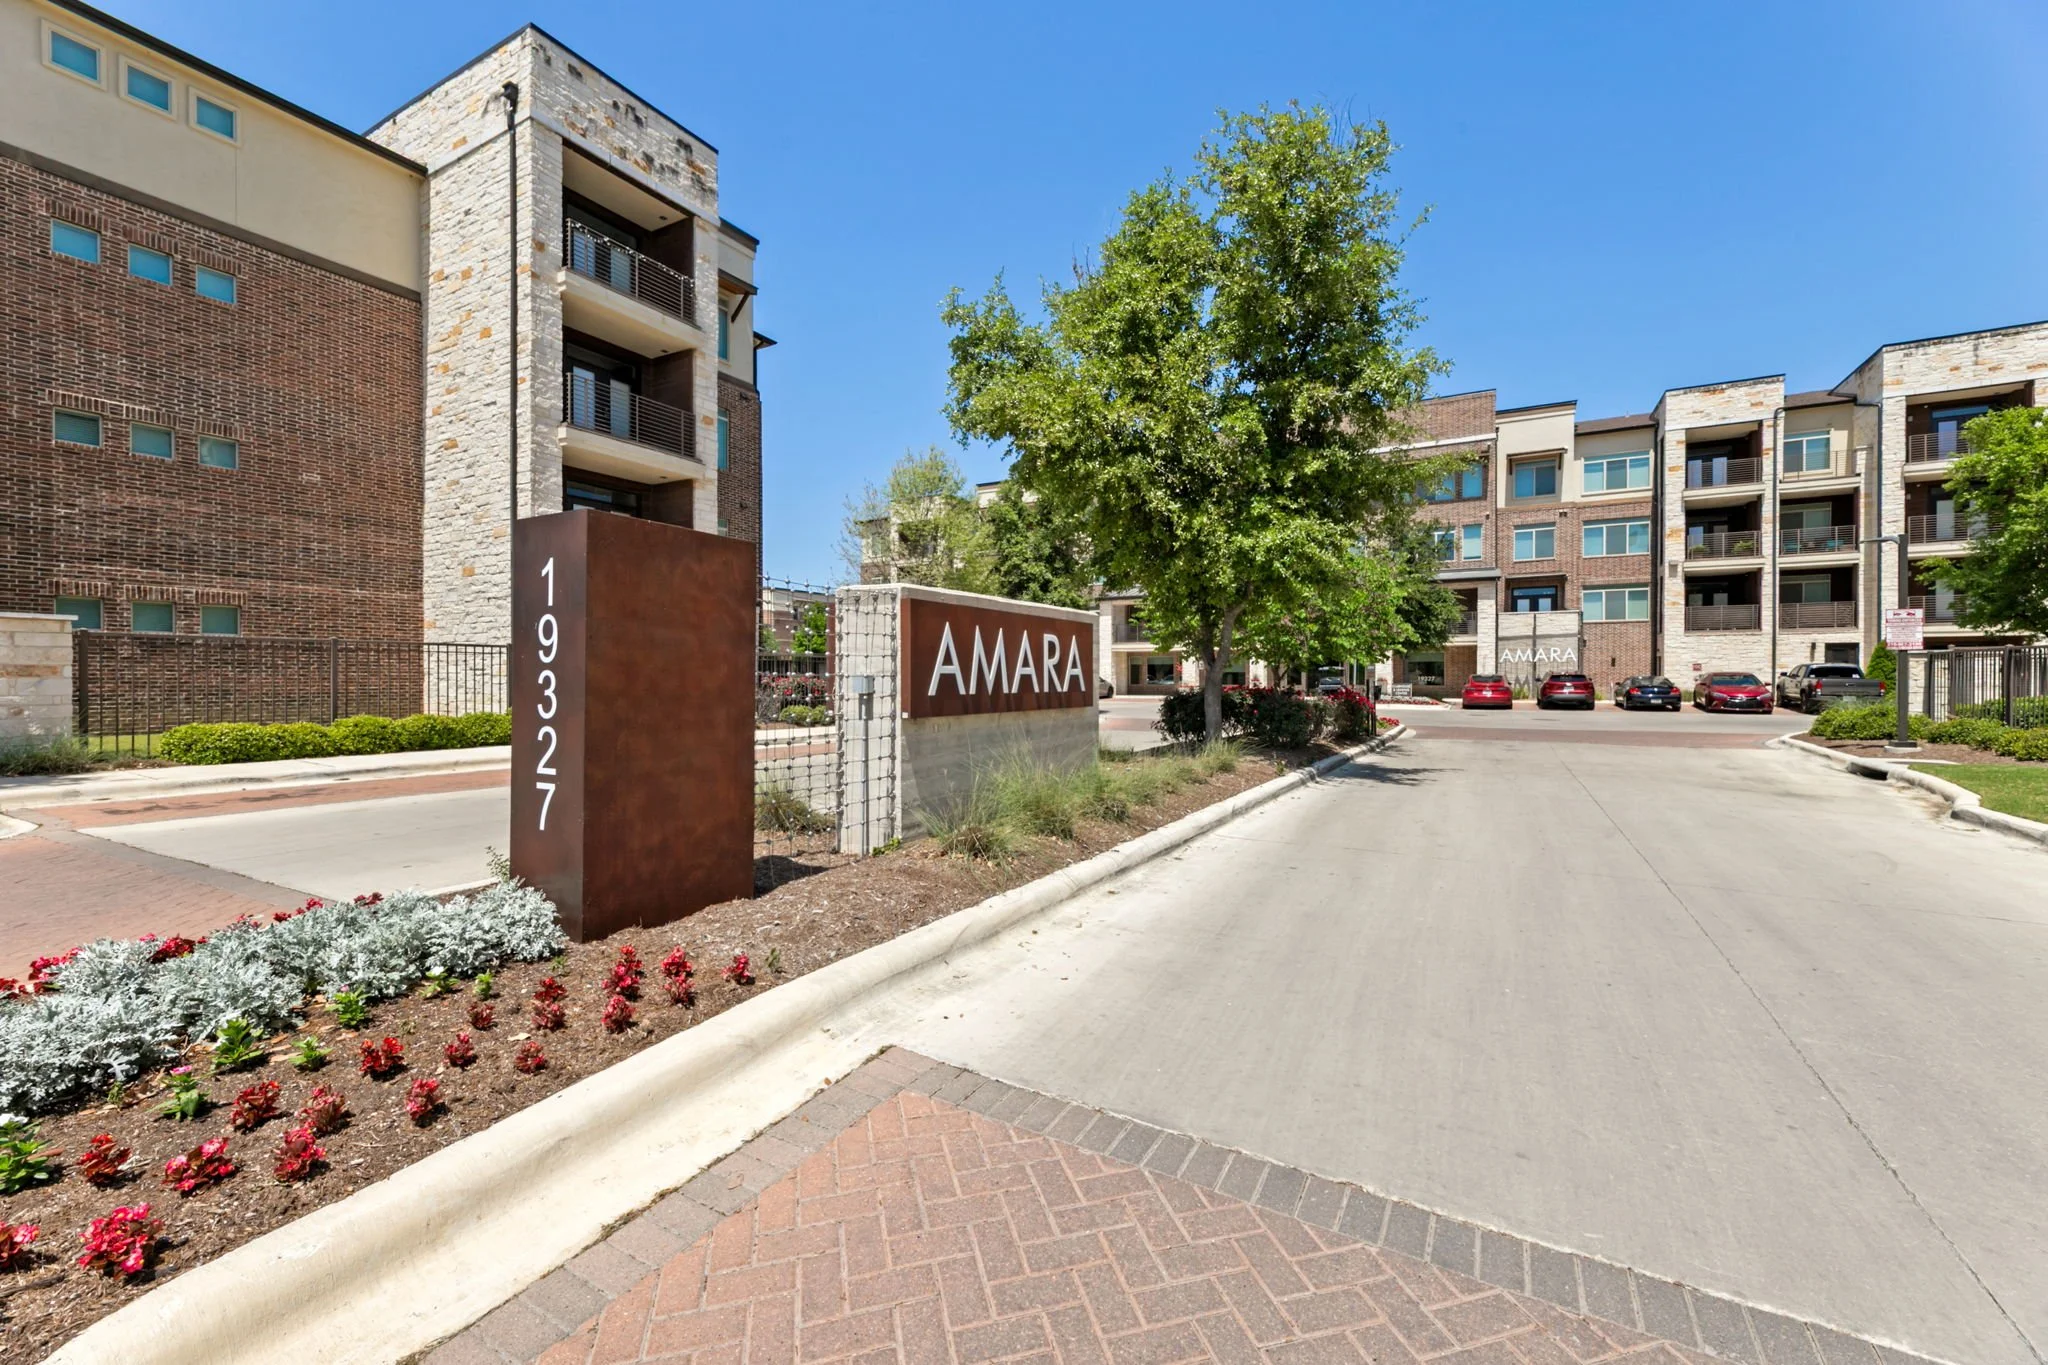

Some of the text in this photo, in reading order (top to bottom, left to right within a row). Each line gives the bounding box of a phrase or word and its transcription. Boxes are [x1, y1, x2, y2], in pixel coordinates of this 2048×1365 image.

[928, 621, 1086, 696] AMARA
[1500, 647, 1577, 663] AMARA
[536, 557, 558, 831] 19327
